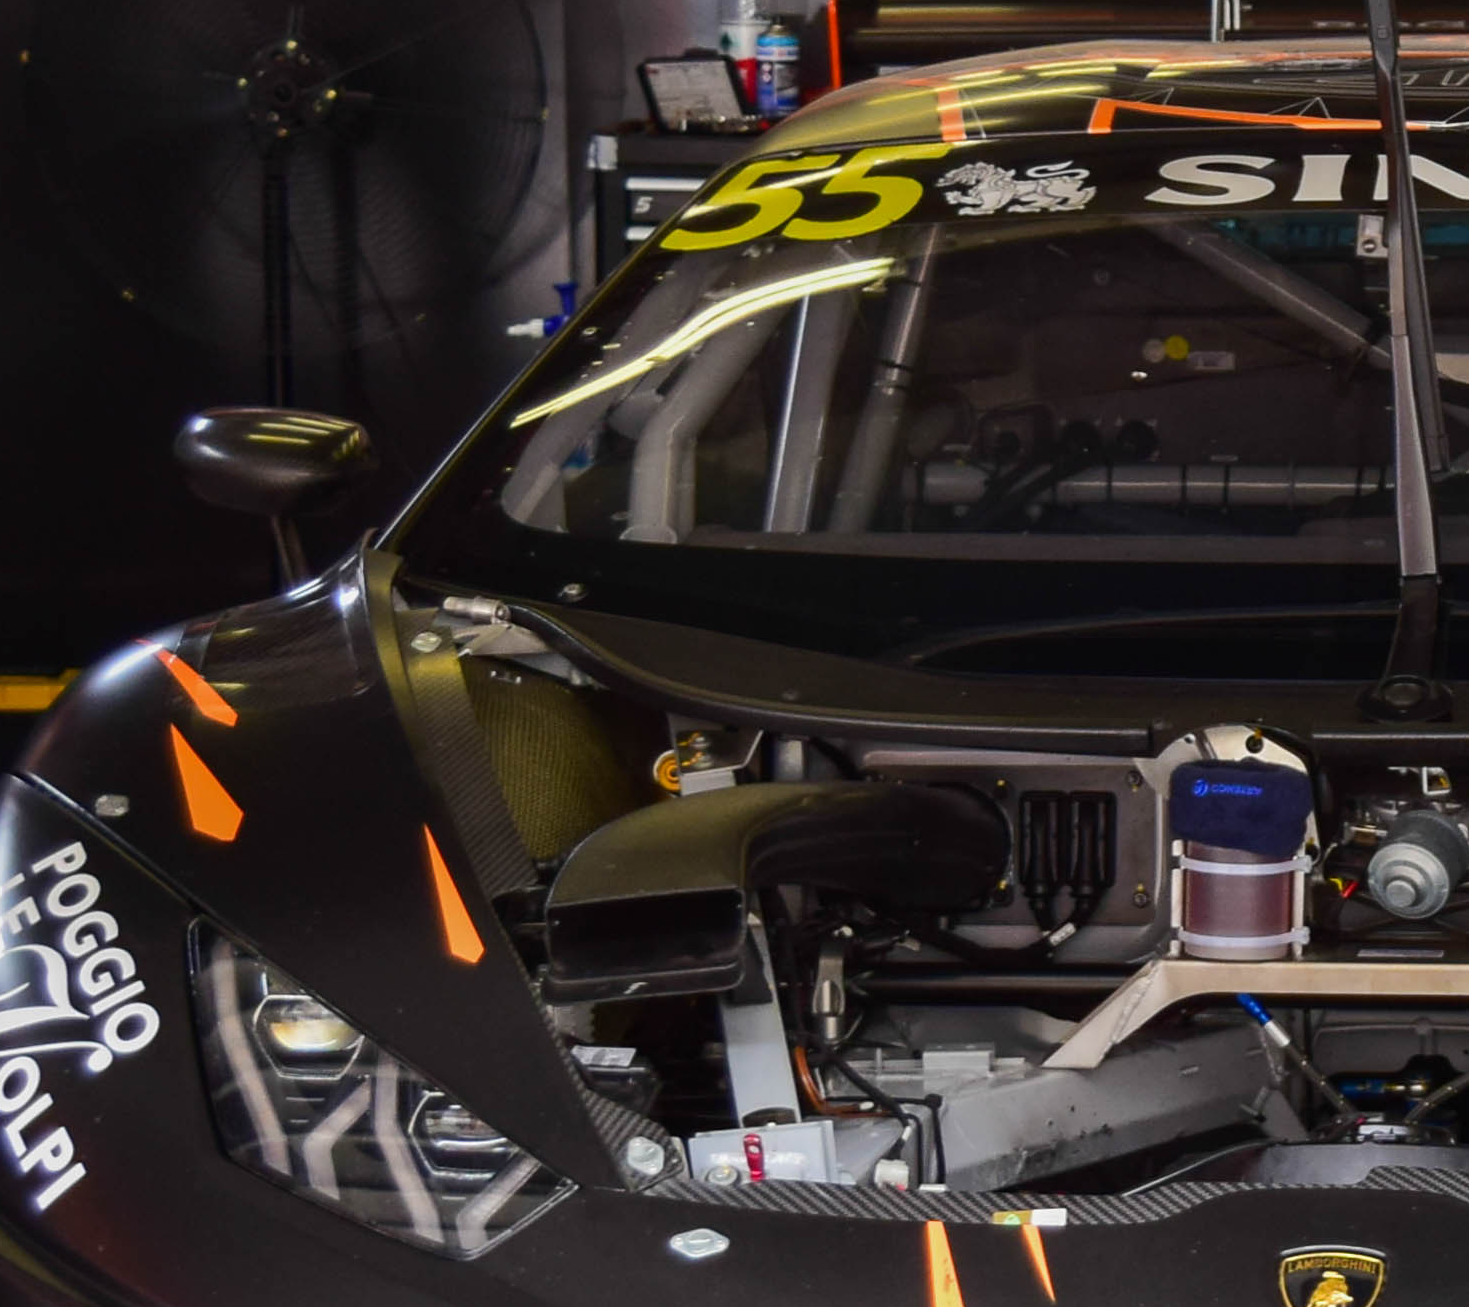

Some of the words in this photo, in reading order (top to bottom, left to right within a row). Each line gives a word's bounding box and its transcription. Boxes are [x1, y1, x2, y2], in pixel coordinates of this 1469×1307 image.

[660, 143, 958, 252] 55
[32, 841, 161, 1055] POGGIO
[1288, 1257, 1377, 1274] LAMBORGHINI
